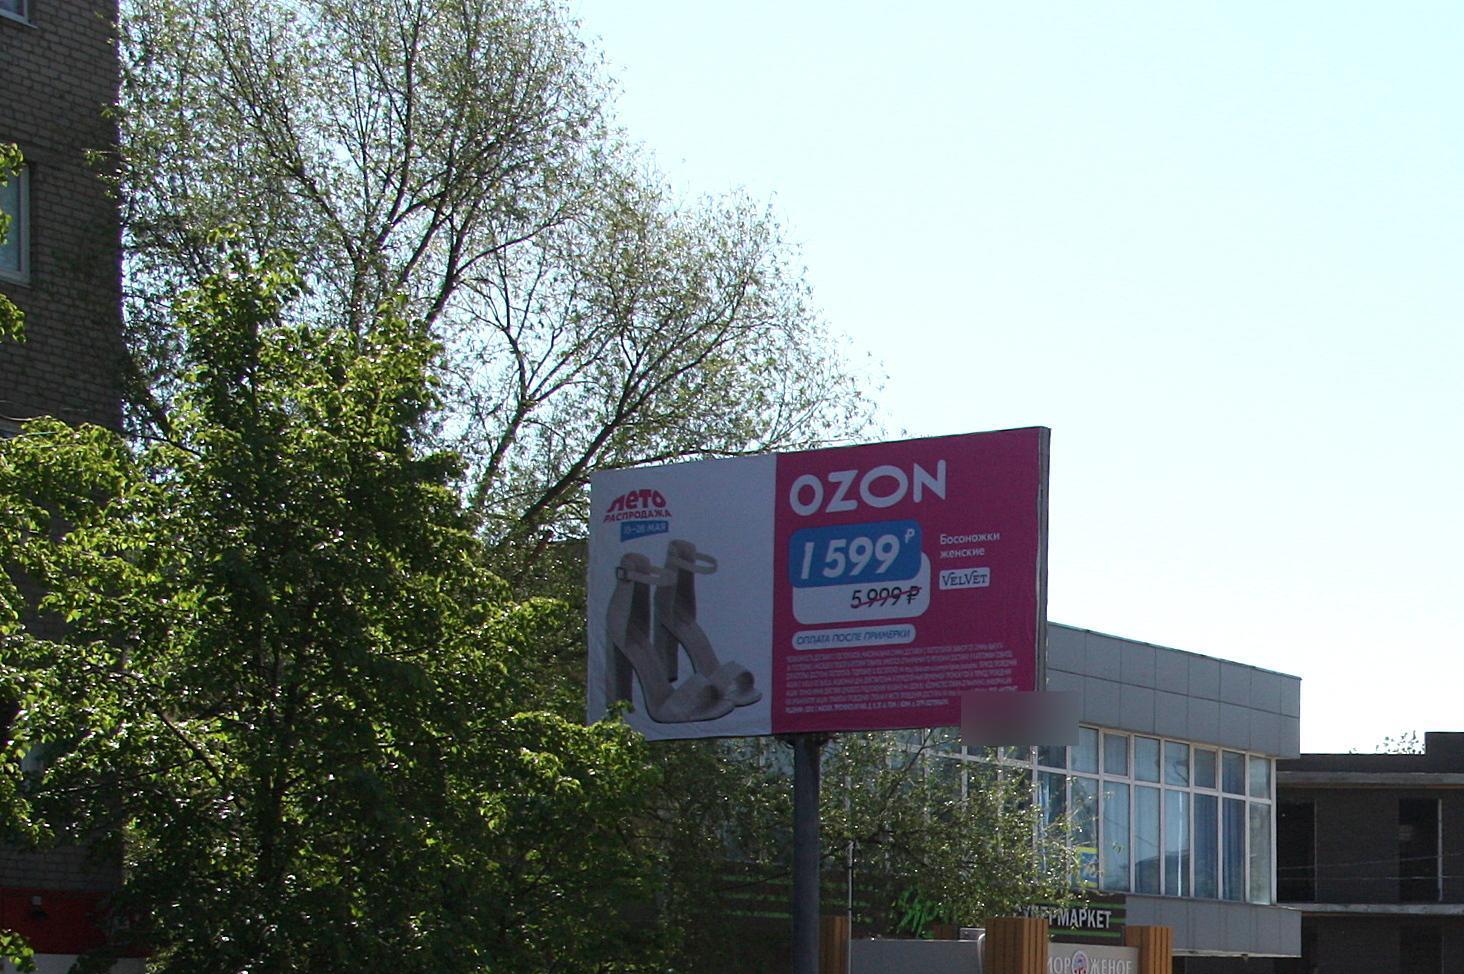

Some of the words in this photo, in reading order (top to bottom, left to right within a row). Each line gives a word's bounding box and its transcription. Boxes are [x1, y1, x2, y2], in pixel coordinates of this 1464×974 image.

[789, 459, 947, 517] OZON
[603, 510, 672, 523] РАСПРОДАЖА
[939, 532, 1001, 546] Босоножки
[939, 546, 985, 559] женские
[941, 569, 988, 586] VELVET
[796, 634, 832, 646] ОПЛАТА
[832, 631, 862, 642] ПОСЛЕ
[863, 628, 911, 641] ПРИМЕРКИ
